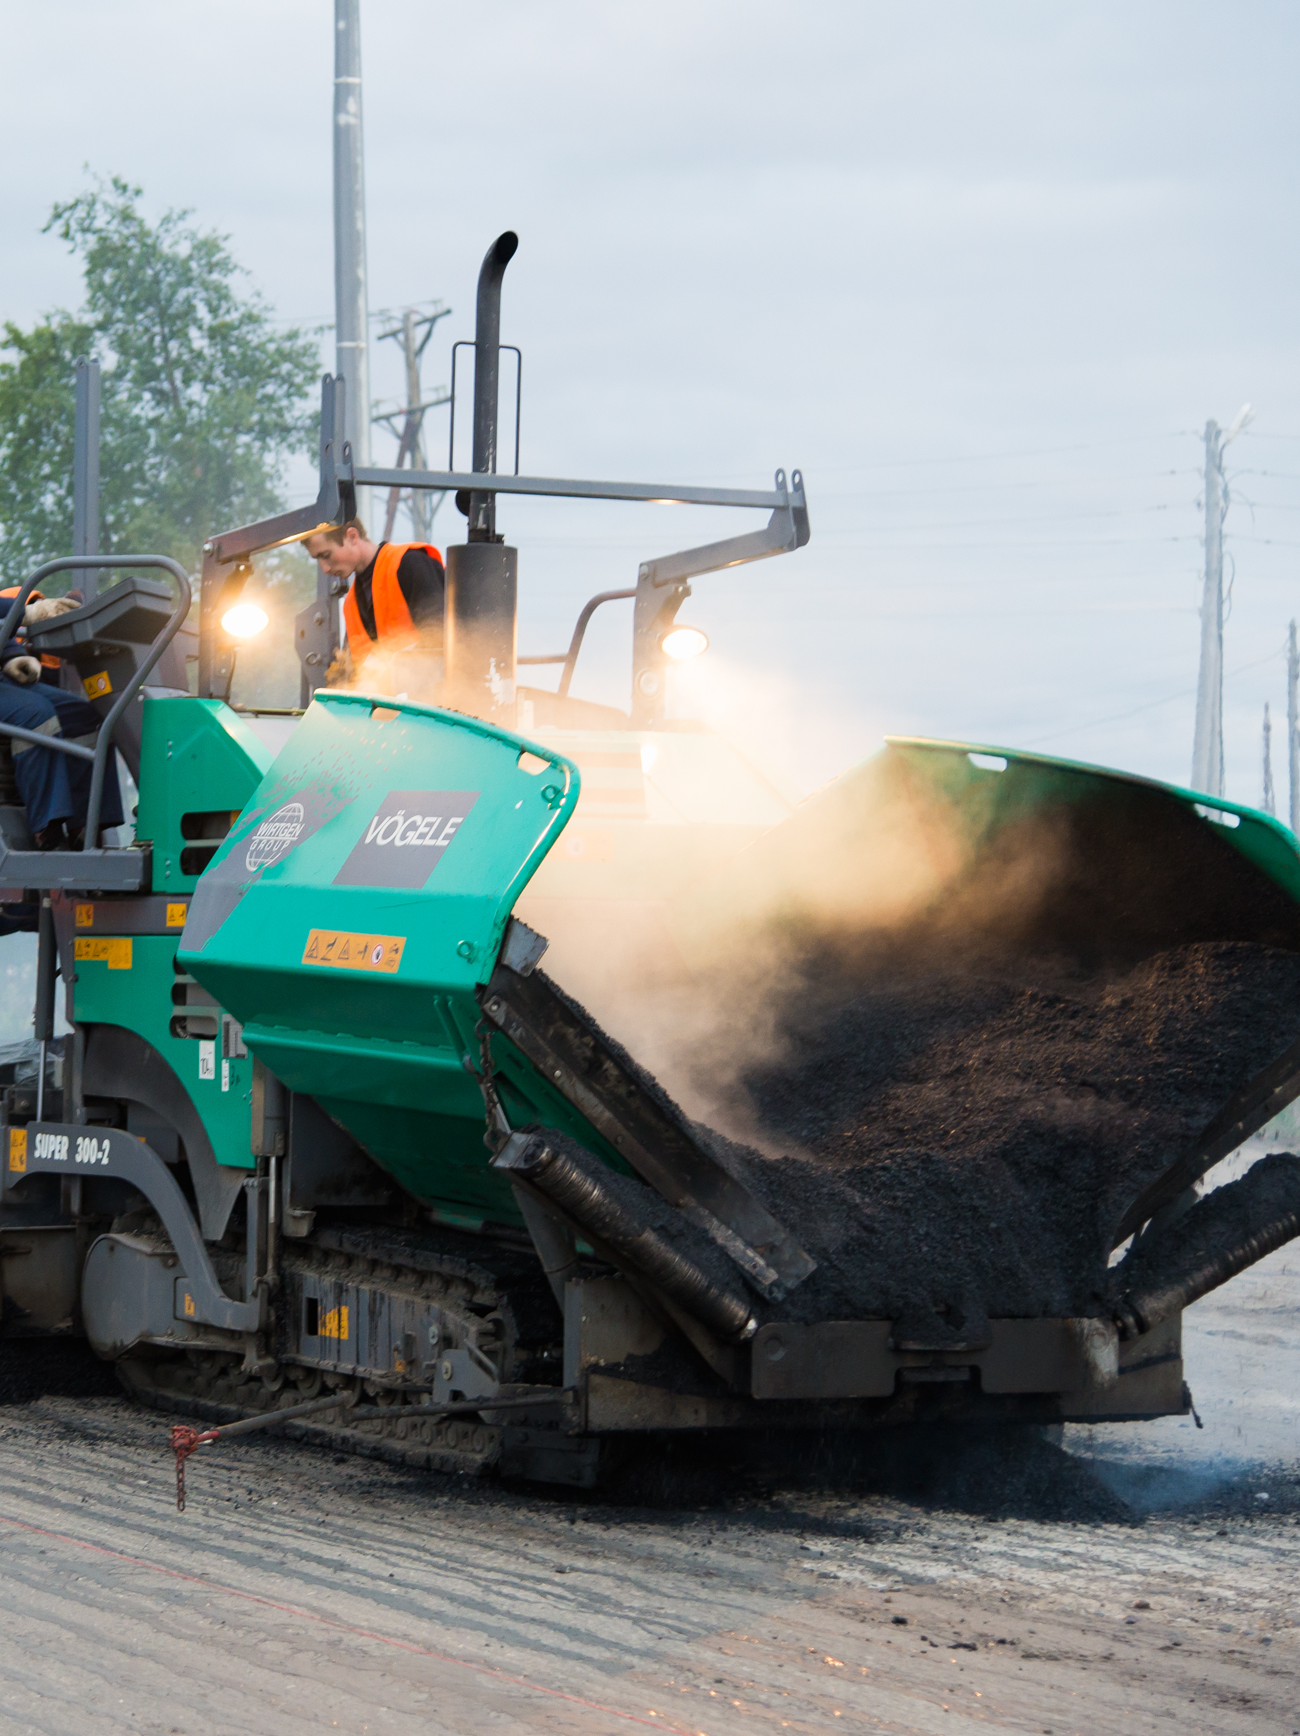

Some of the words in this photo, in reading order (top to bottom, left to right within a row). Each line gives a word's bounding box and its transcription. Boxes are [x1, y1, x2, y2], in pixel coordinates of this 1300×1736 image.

[256, 821, 306, 838] WIRTGEN
[364, 809, 464, 847] VÖGELE
[250, 839, 292, 852] GROUP
[33, 1133, 69, 1160] SUPER
[75, 1136, 110, 1165] 300-2
